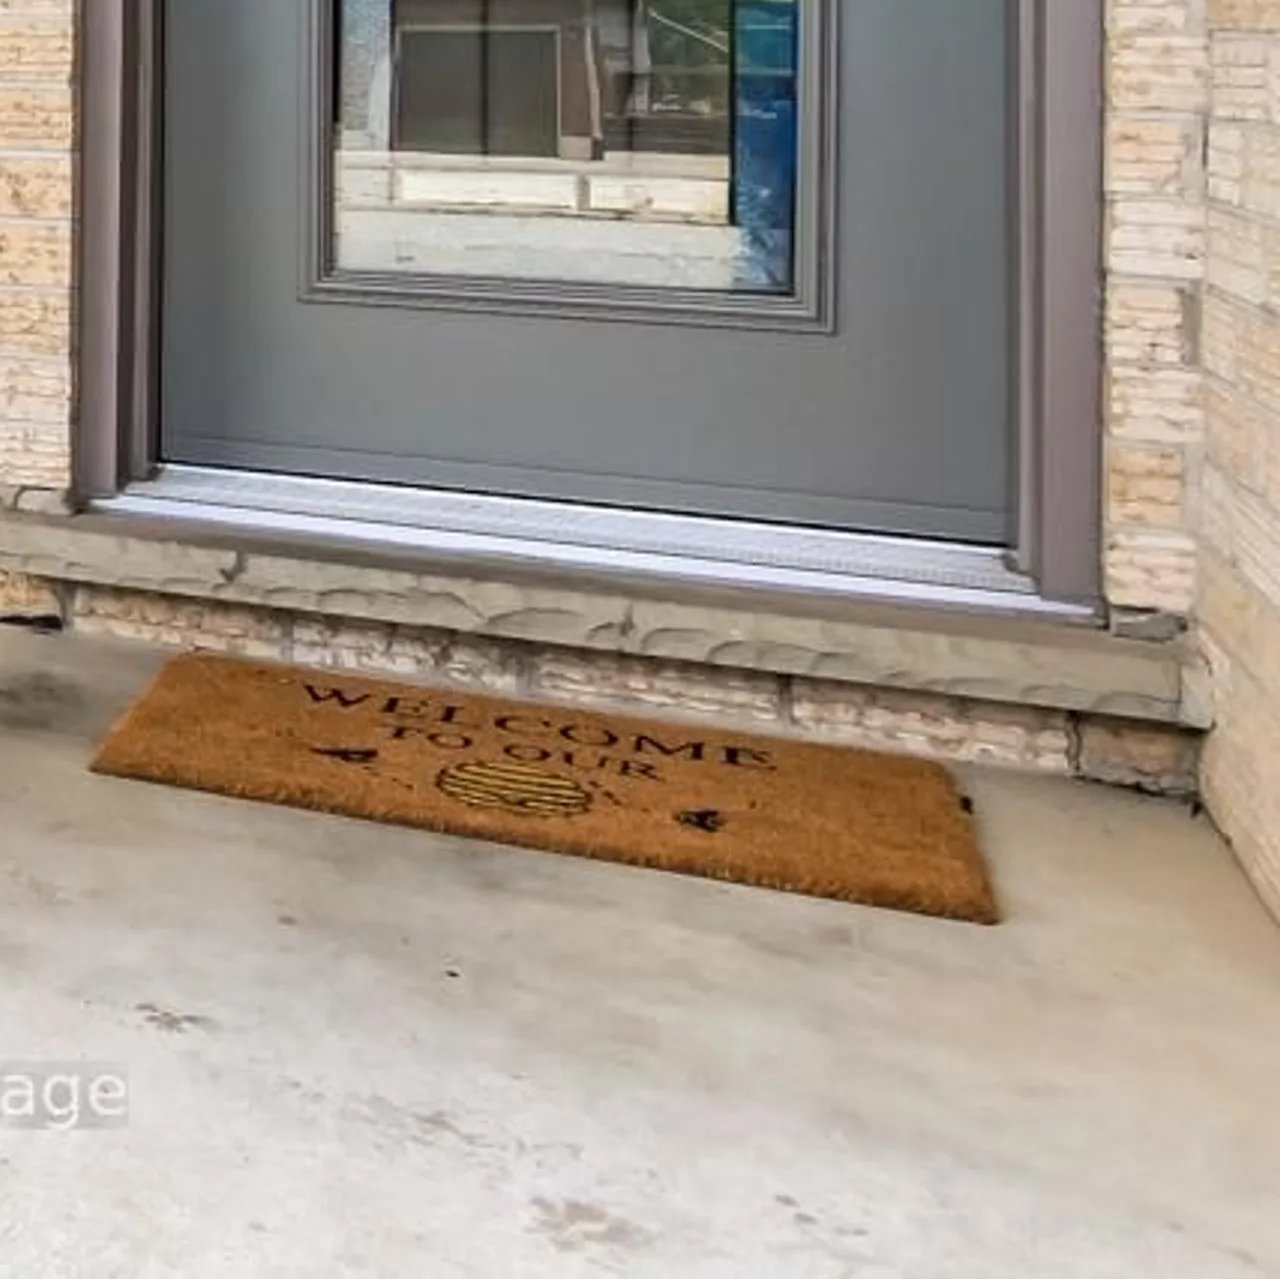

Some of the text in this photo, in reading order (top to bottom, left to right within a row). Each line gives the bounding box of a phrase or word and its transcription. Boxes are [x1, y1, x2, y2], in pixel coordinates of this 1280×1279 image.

[303, 684, 778, 771] WELCOME
[392, 726, 664, 782] TO OUR
